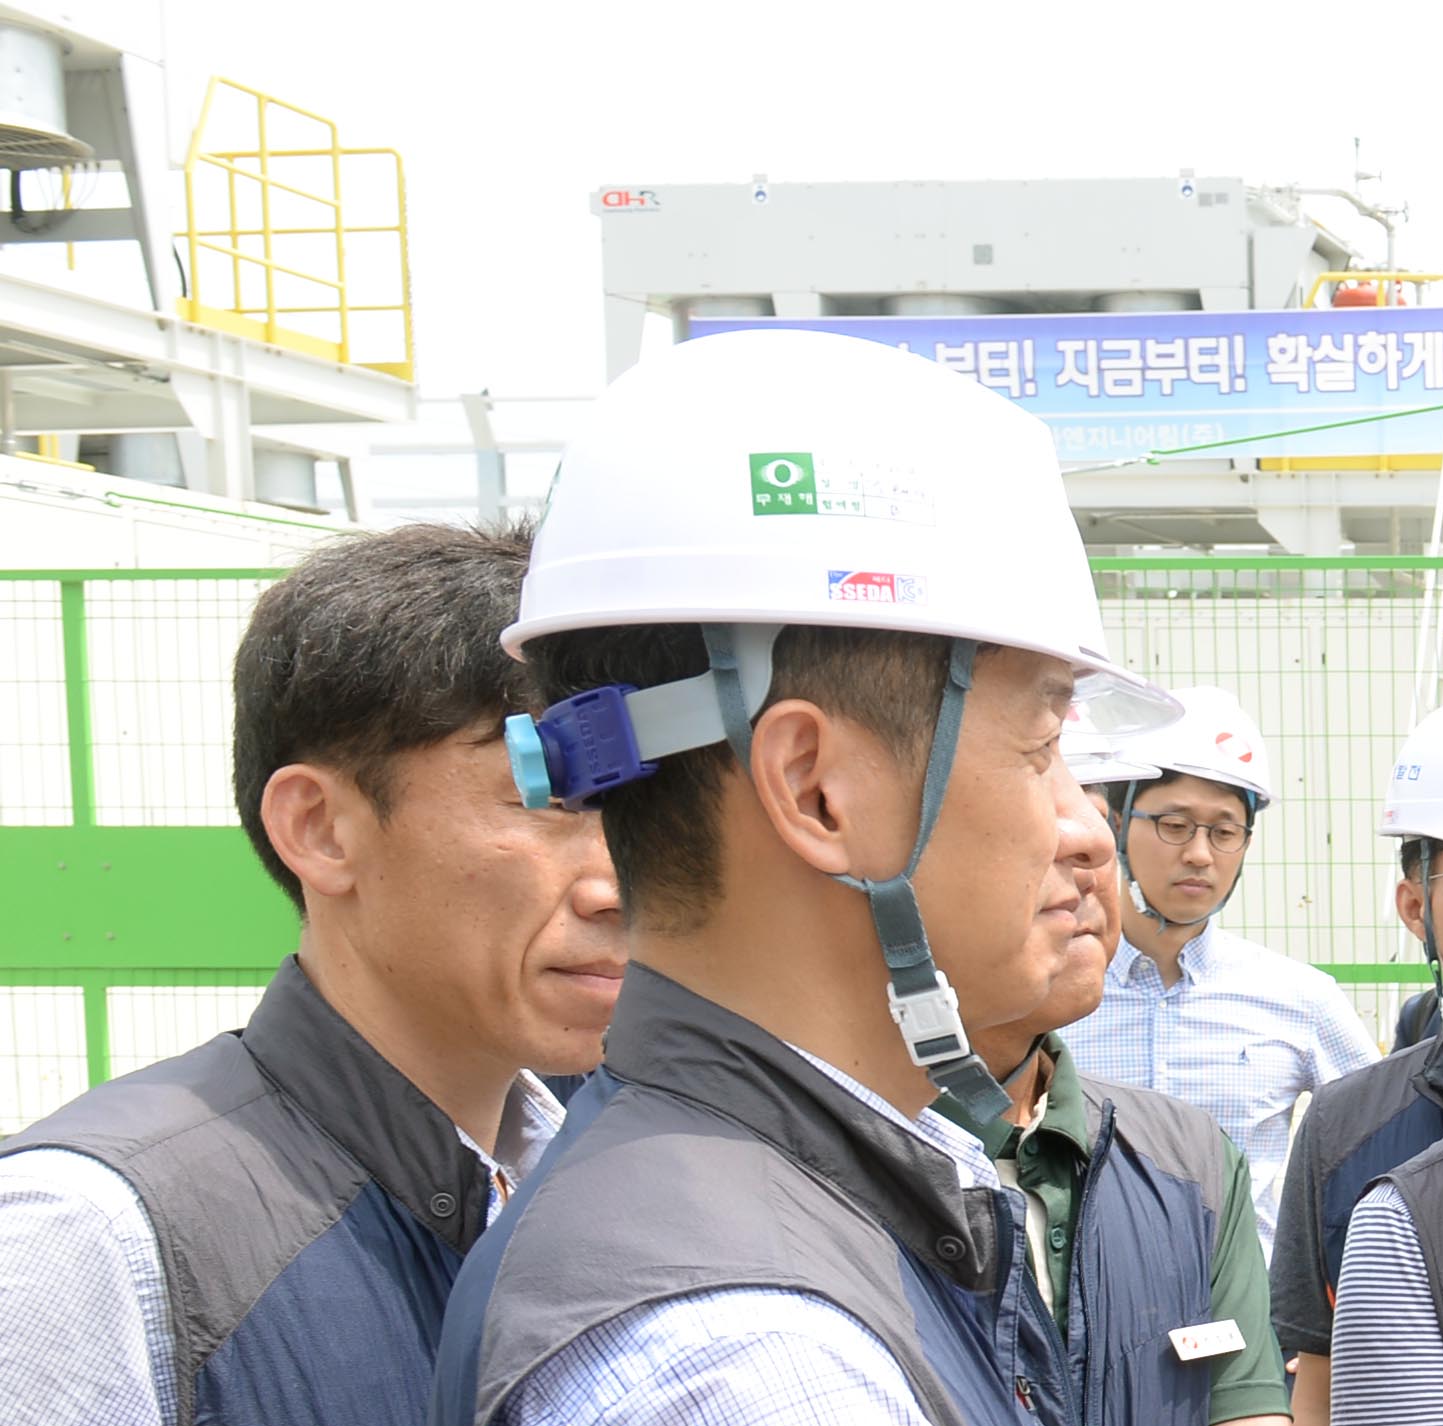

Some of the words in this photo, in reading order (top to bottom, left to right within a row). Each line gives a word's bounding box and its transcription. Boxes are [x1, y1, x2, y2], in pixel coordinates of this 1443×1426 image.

[898, 337, 1039, 399] 부터!
[1055, 333, 1248, 398] 지금부터!
[1052, 421, 1225, 452] 엔지니어링(주)
[829, 582, 894, 602] SSEDA
